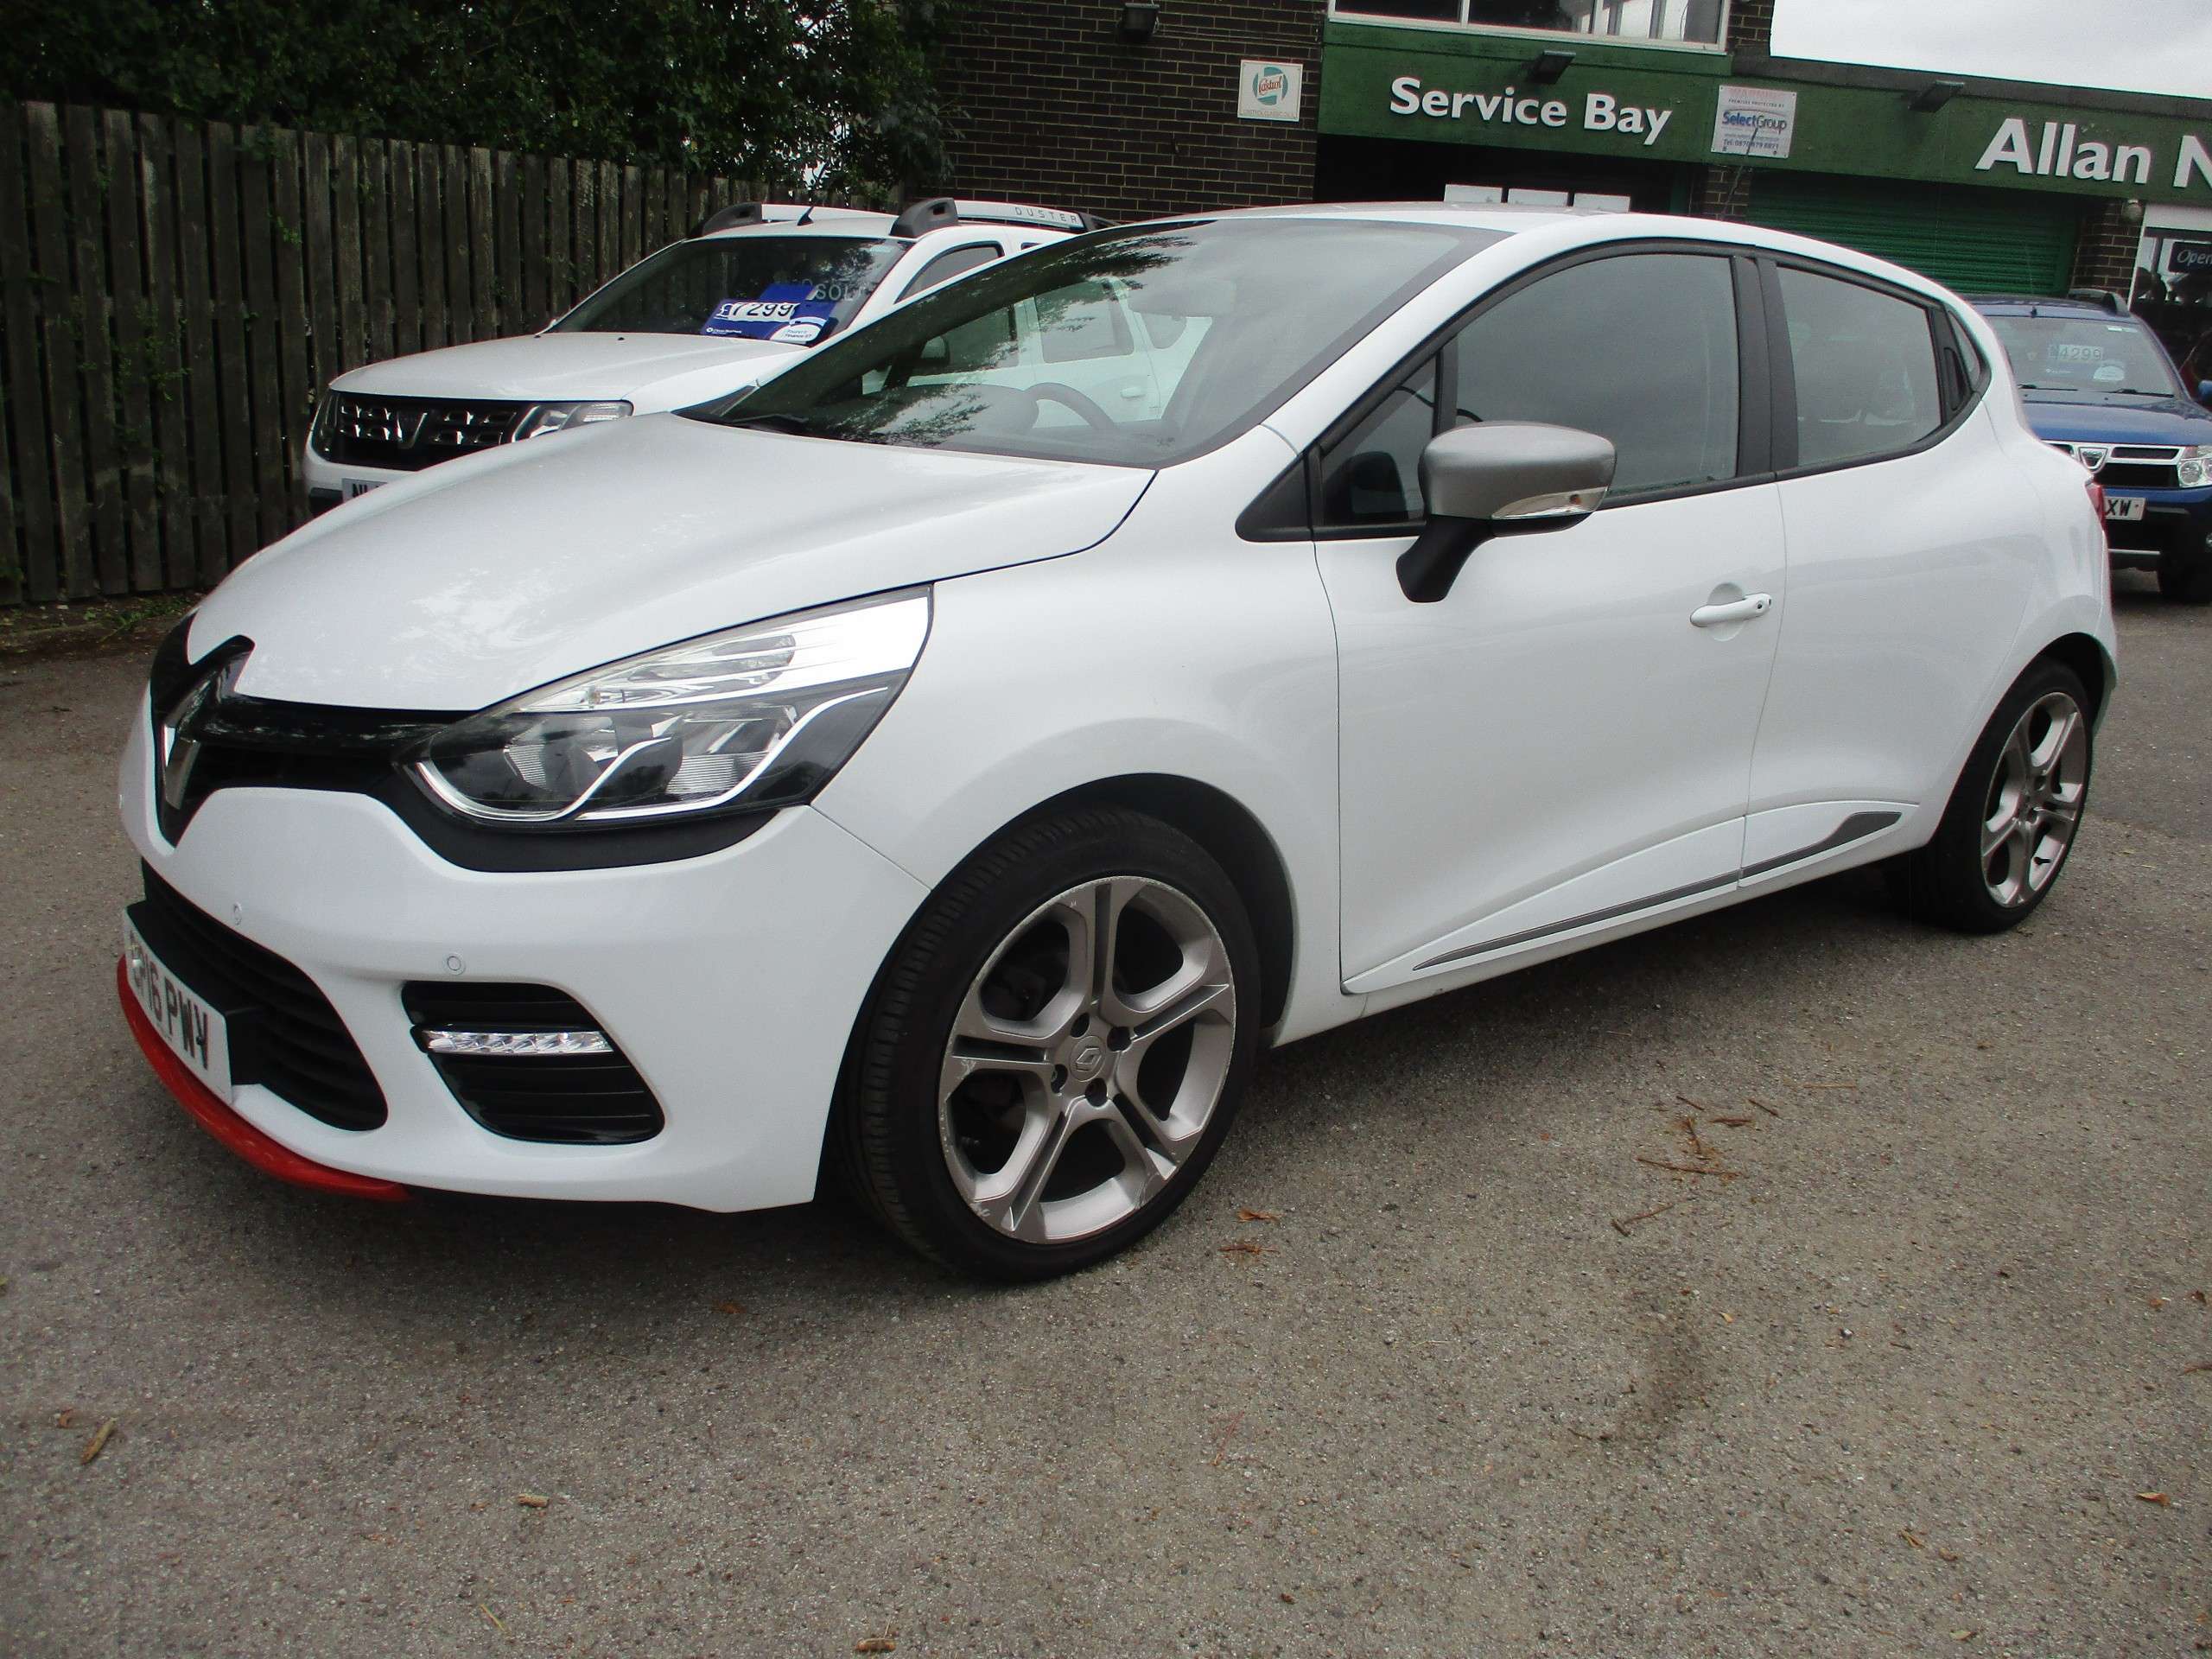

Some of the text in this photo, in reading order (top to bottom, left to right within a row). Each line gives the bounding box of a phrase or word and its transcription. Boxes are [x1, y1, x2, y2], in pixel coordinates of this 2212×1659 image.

[1258, 75, 1283, 96] Castrol
[1390, 76, 1673, 146] Service Bay
[1722, 111, 1788, 135] SelectGroup
[1974, 118, 2152, 185] Allan
[1014, 207, 1077, 224] DUSTER
[164, 976, 208, 1071] PWY
